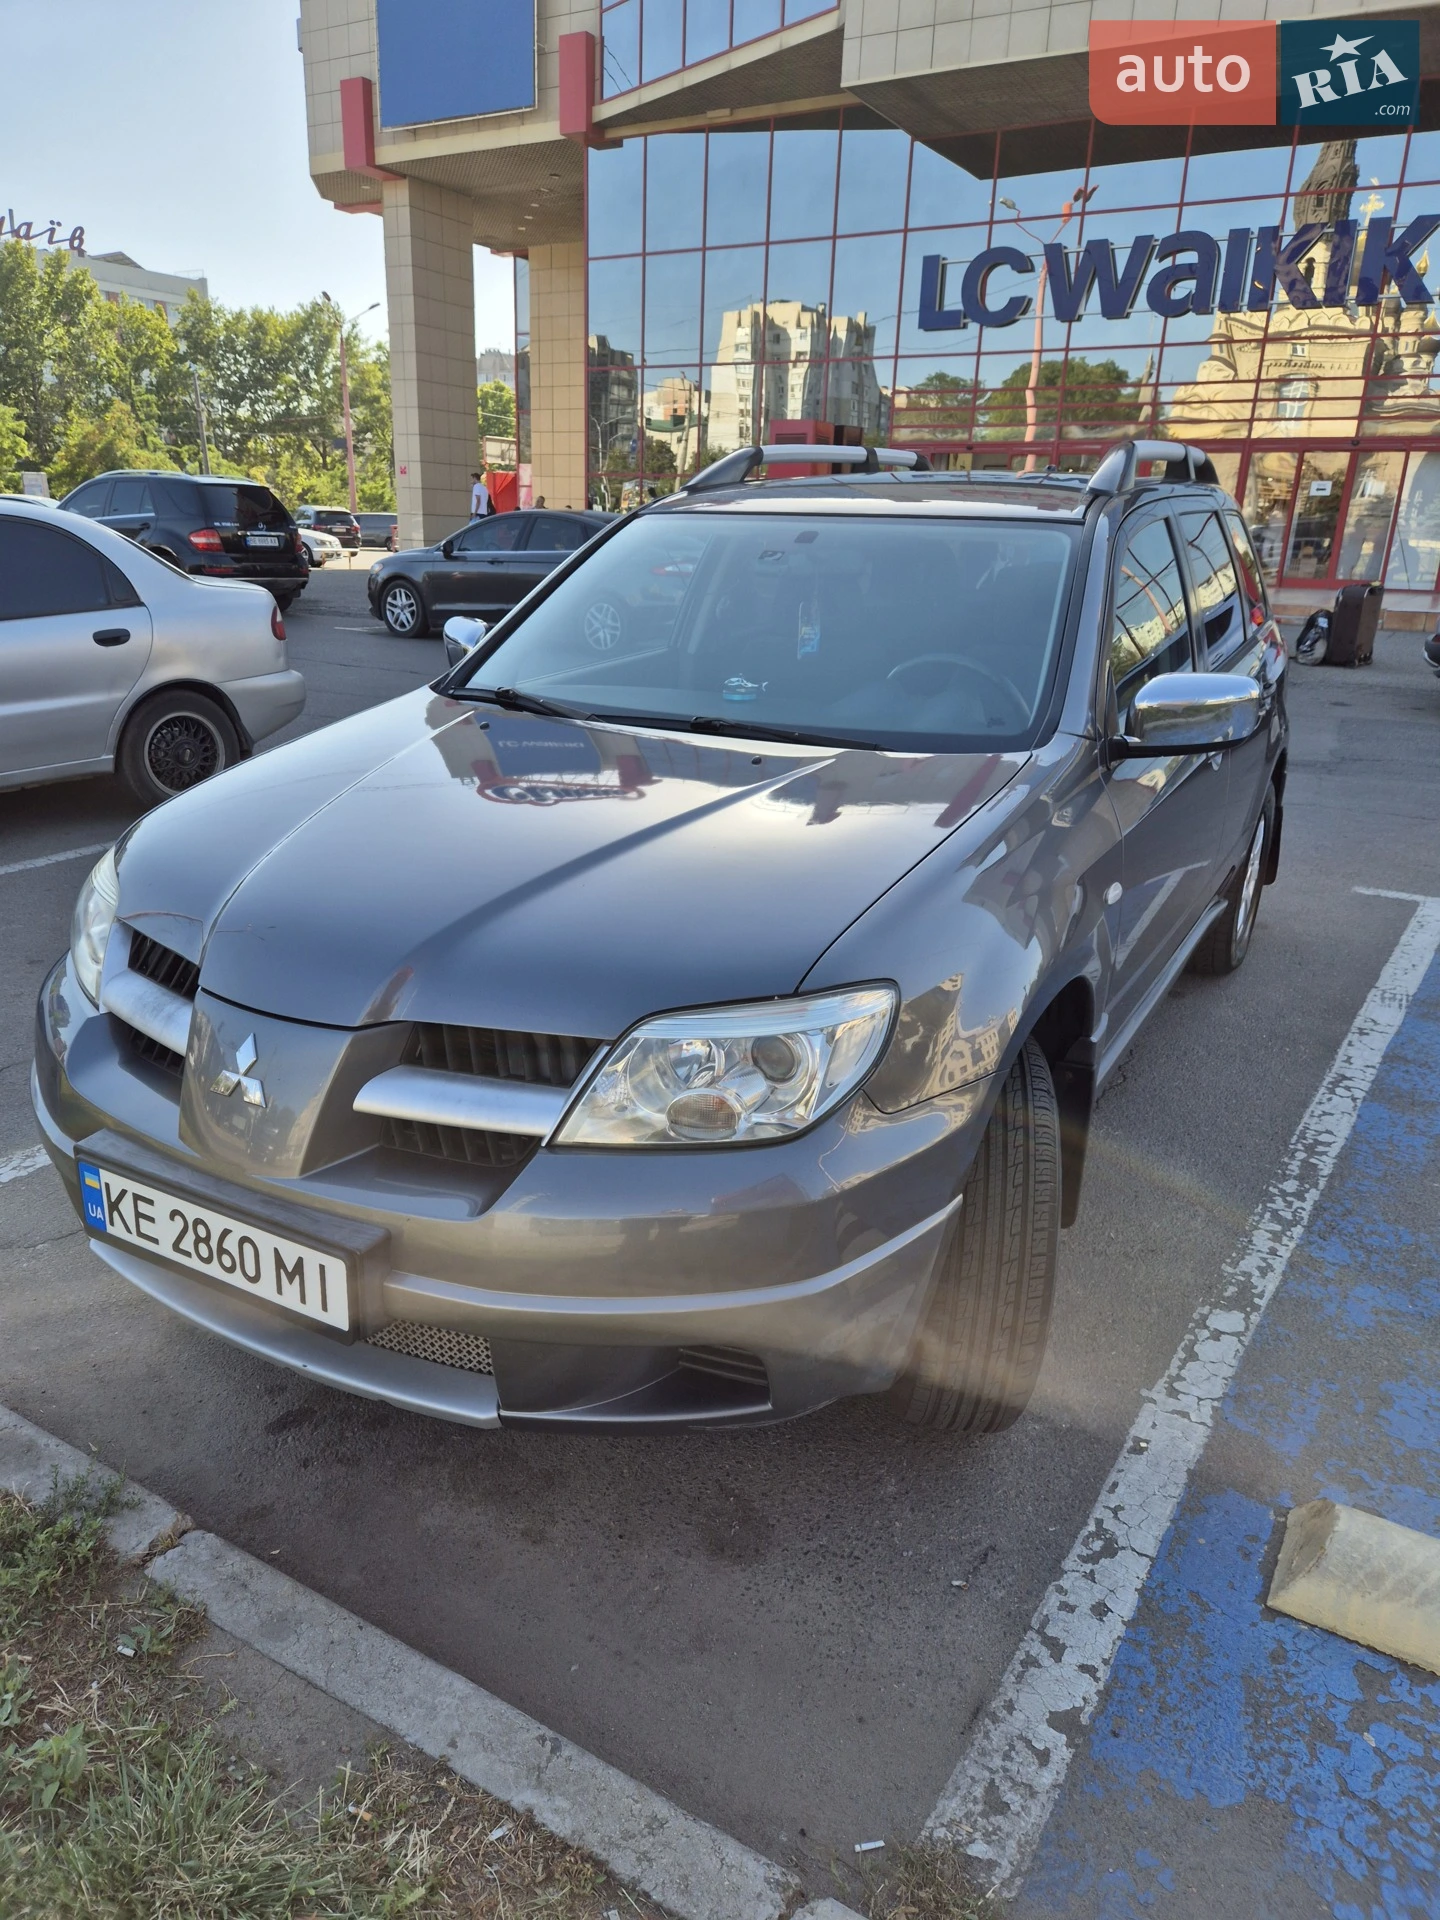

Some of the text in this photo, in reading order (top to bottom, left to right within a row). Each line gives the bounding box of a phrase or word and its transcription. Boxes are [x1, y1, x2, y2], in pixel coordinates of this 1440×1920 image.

[88, 1203, 104, 1222] UA
[104, 1182, 329, 1313] KE 2860 MI
